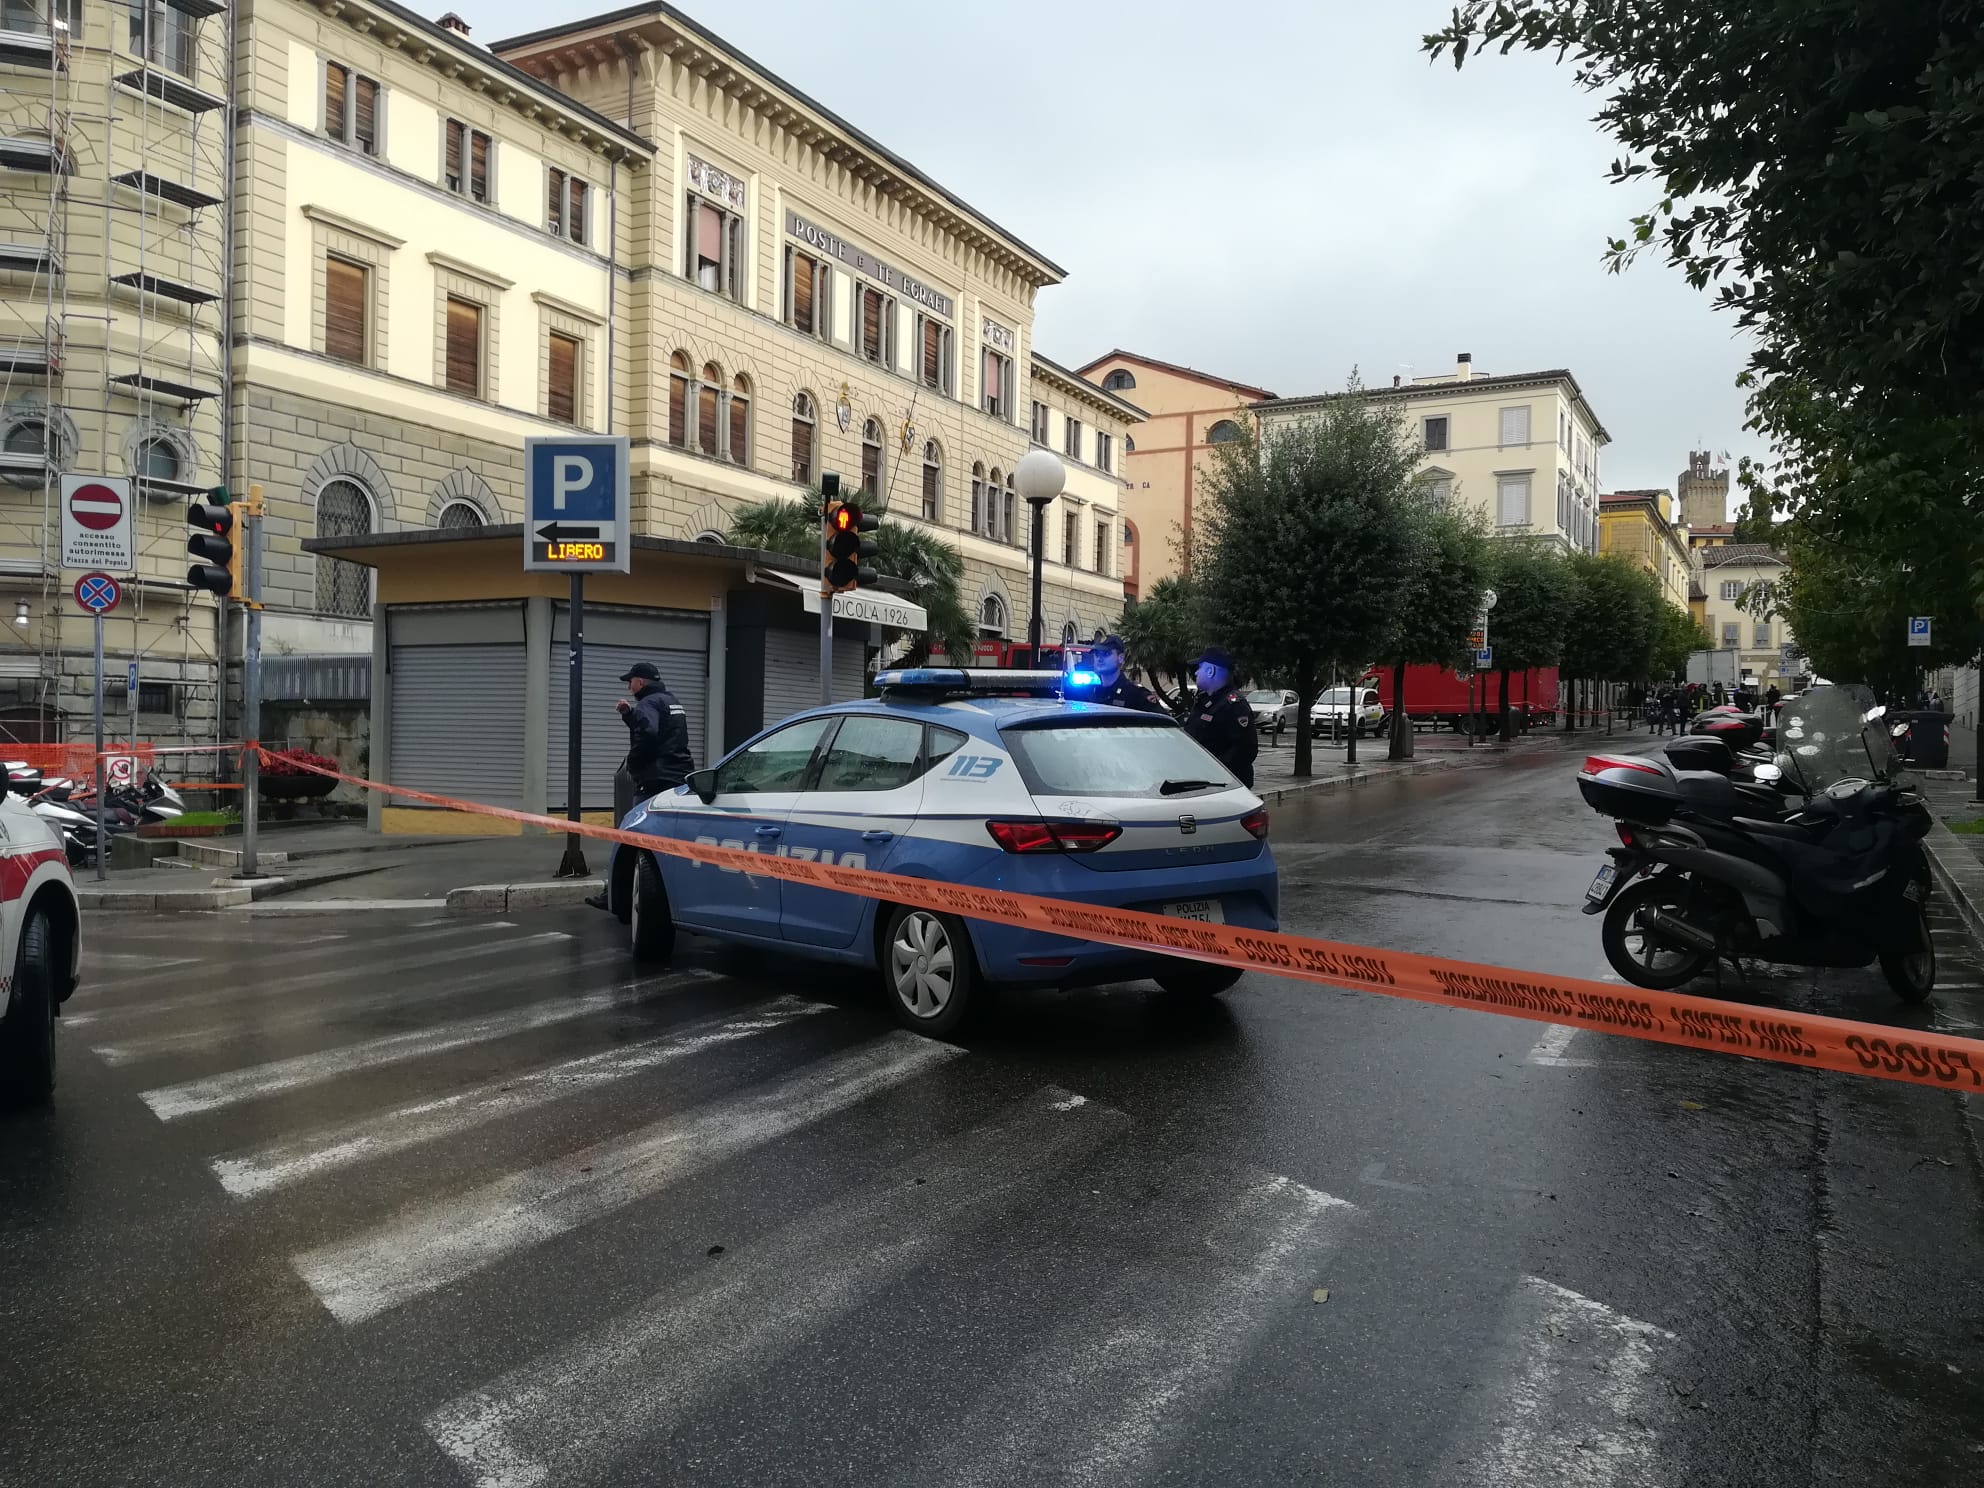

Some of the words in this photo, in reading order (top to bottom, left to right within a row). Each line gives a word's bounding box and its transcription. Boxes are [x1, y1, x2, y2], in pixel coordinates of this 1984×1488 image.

[794, 217, 846, 259] POSTE
[553, 455, 594, 510] P
[69, 548, 125, 557] autorimessa
[73, 541, 121, 549] consentito
[547, 543, 604, 560] LIBERO
[66, 556, 89, 564] Piazza
[832, 598, 879, 622] DICOLA
[883, 608, 909, 626] 1926
[948, 755, 1004, 778] 113
[1176, 902, 1210, 914] POLIZIA
